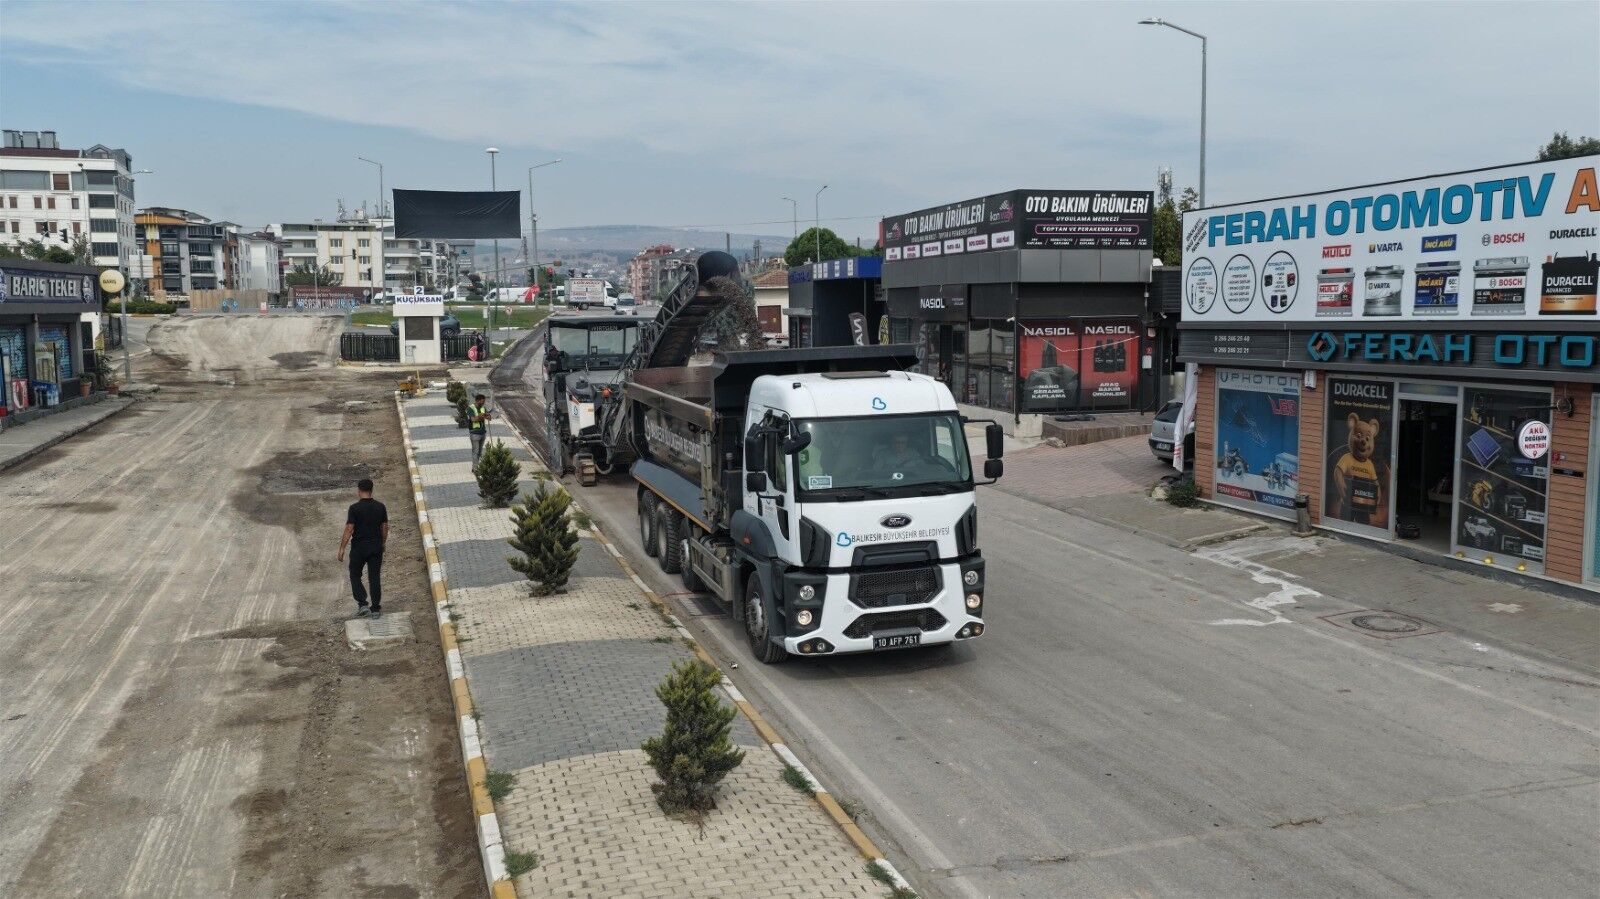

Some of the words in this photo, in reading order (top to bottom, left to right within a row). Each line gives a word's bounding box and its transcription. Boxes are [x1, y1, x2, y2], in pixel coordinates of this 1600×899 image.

[1025, 196, 1048, 213] OTO
[1051, 196, 1090, 213] BAKIM
[1092, 194, 1150, 214] ÜRÜNLERİ
[1208, 204, 1317, 247] FERAH
[1325, 172, 1556, 236] OTOMOTİV
[904, 218, 918, 235] OTO
[919, 212, 944, 233] BAKIM
[945, 198, 986, 228] ÜRÜNLERİ
[1493, 233, 1525, 244] BOSCH
[1549, 227, 1596, 240] DURACELL
[1322, 245, 1352, 258] MUTLU
[1376, 242, 1403, 253] VARTA
[1498, 278, 1523, 287] BOSCH
[1546, 276, 1593, 287] DURACELL
[50, 280, 78, 297] TEKEL
[920, 299, 945, 309] NASIOL
[1024, 327, 1074, 336] NASIOL
[1085, 326, 1134, 334] NASIOL
[1344, 333, 1473, 364] FERAH
[1494, 334, 1595, 368] OTO
[1334, 382, 1387, 399] DURACELL
[852, 532, 882, 542] BALIKESİR
[884, 530, 917, 540] BÜYÜKŞEHİR
[918, 526, 950, 538] BELEDİYESİ
[878, 639, 886, 647] 10
[904, 636, 917, 644] 761
